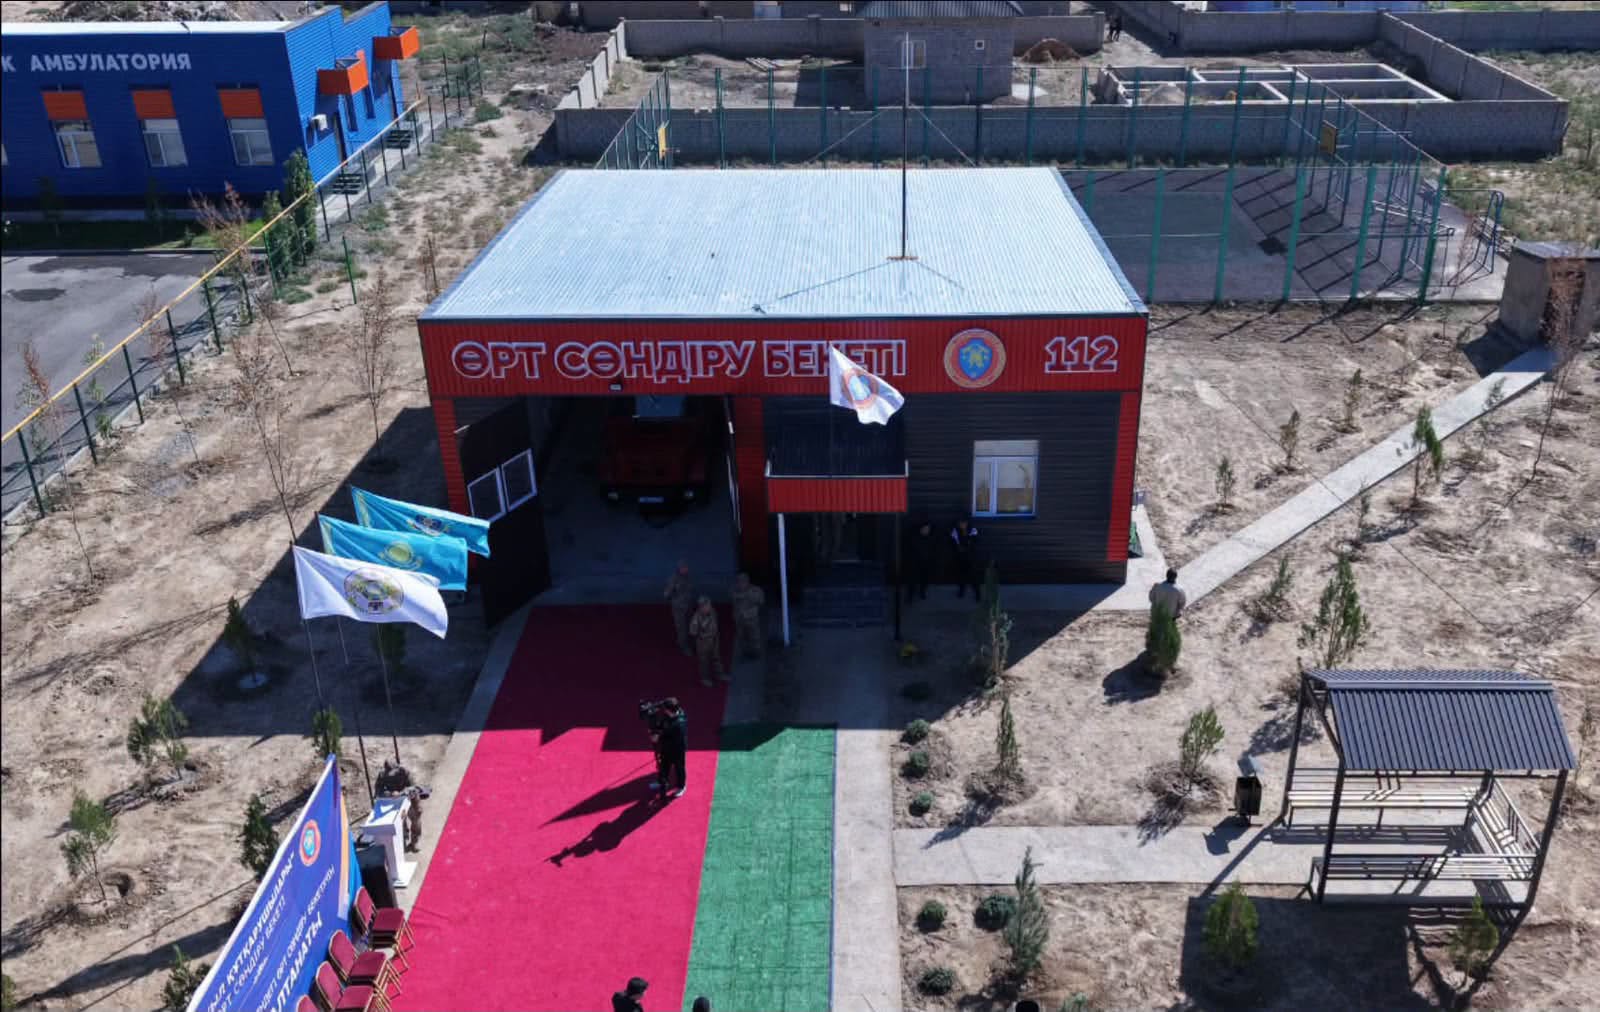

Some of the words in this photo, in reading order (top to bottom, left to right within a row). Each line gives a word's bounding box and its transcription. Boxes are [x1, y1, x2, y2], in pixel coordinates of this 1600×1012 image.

[30, 52, 192, 72] АМБУЛАТОРИЯ
[451, 341, 546, 379] ӨРТ
[554, 340, 756, 384] СӨНДІРУ
[1044, 335, 1119, 373] 112
[270, 911, 323, 1012] ЛТАНАТЫ
